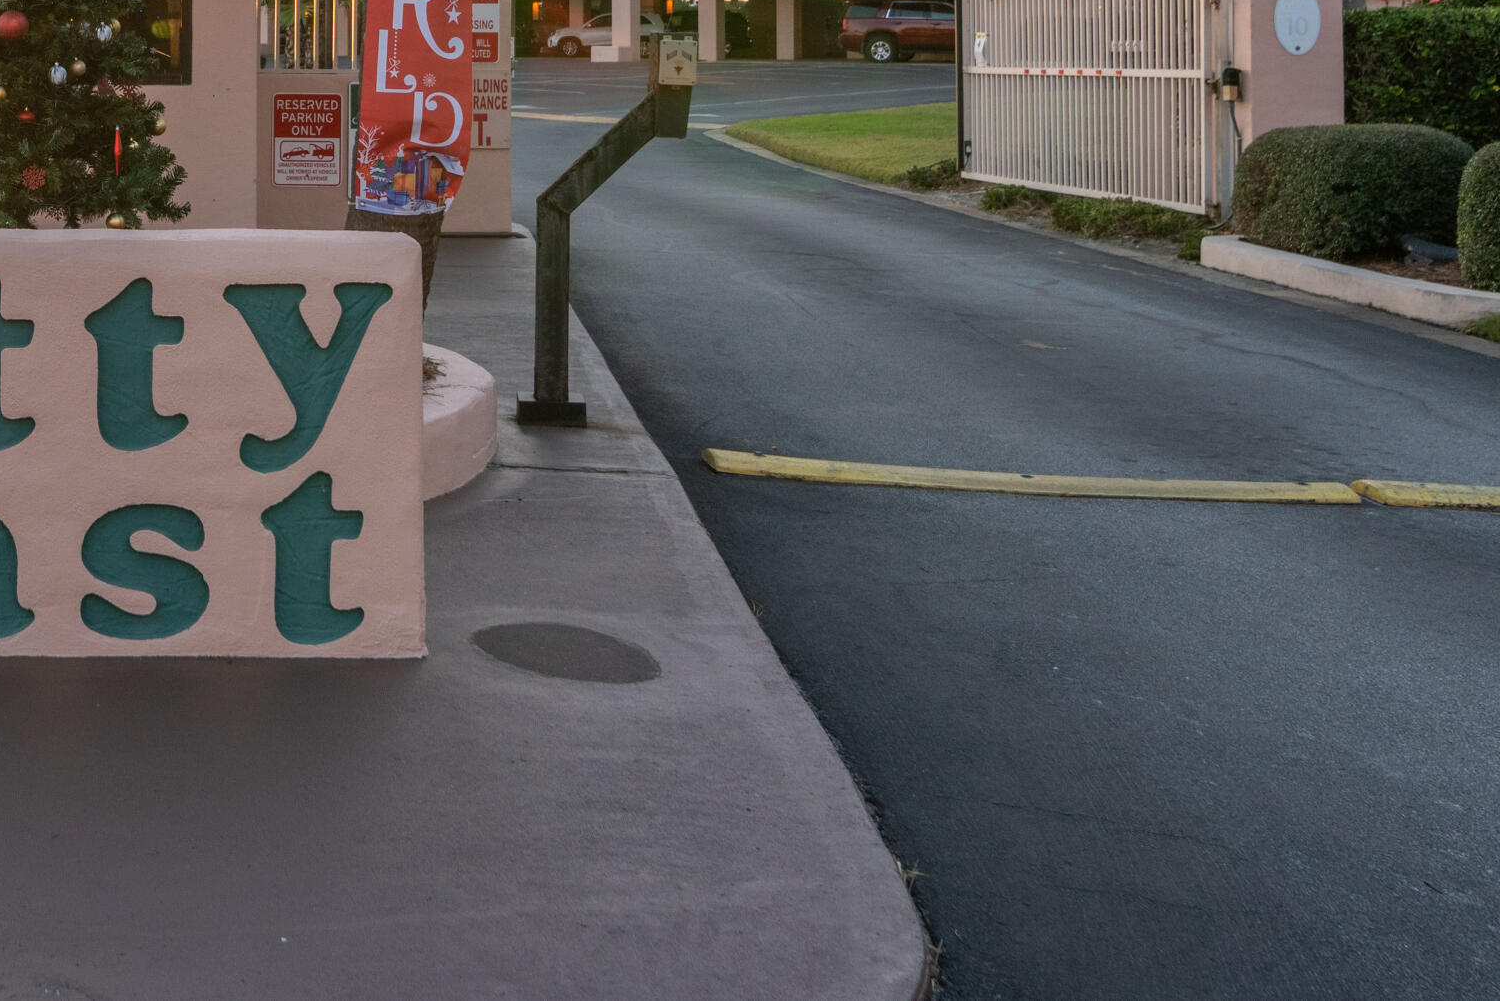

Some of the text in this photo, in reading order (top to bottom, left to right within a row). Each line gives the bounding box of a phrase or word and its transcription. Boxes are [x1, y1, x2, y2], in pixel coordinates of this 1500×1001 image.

[476, 38, 491, 48] WILL
[473, 78, 508, 94] ILDING
[276, 99, 339, 111] RESERVED
[473, 95, 508, 111] RANCE
[281, 112, 334, 124] PARKING
[291, 125, 323, 136] ONLY
